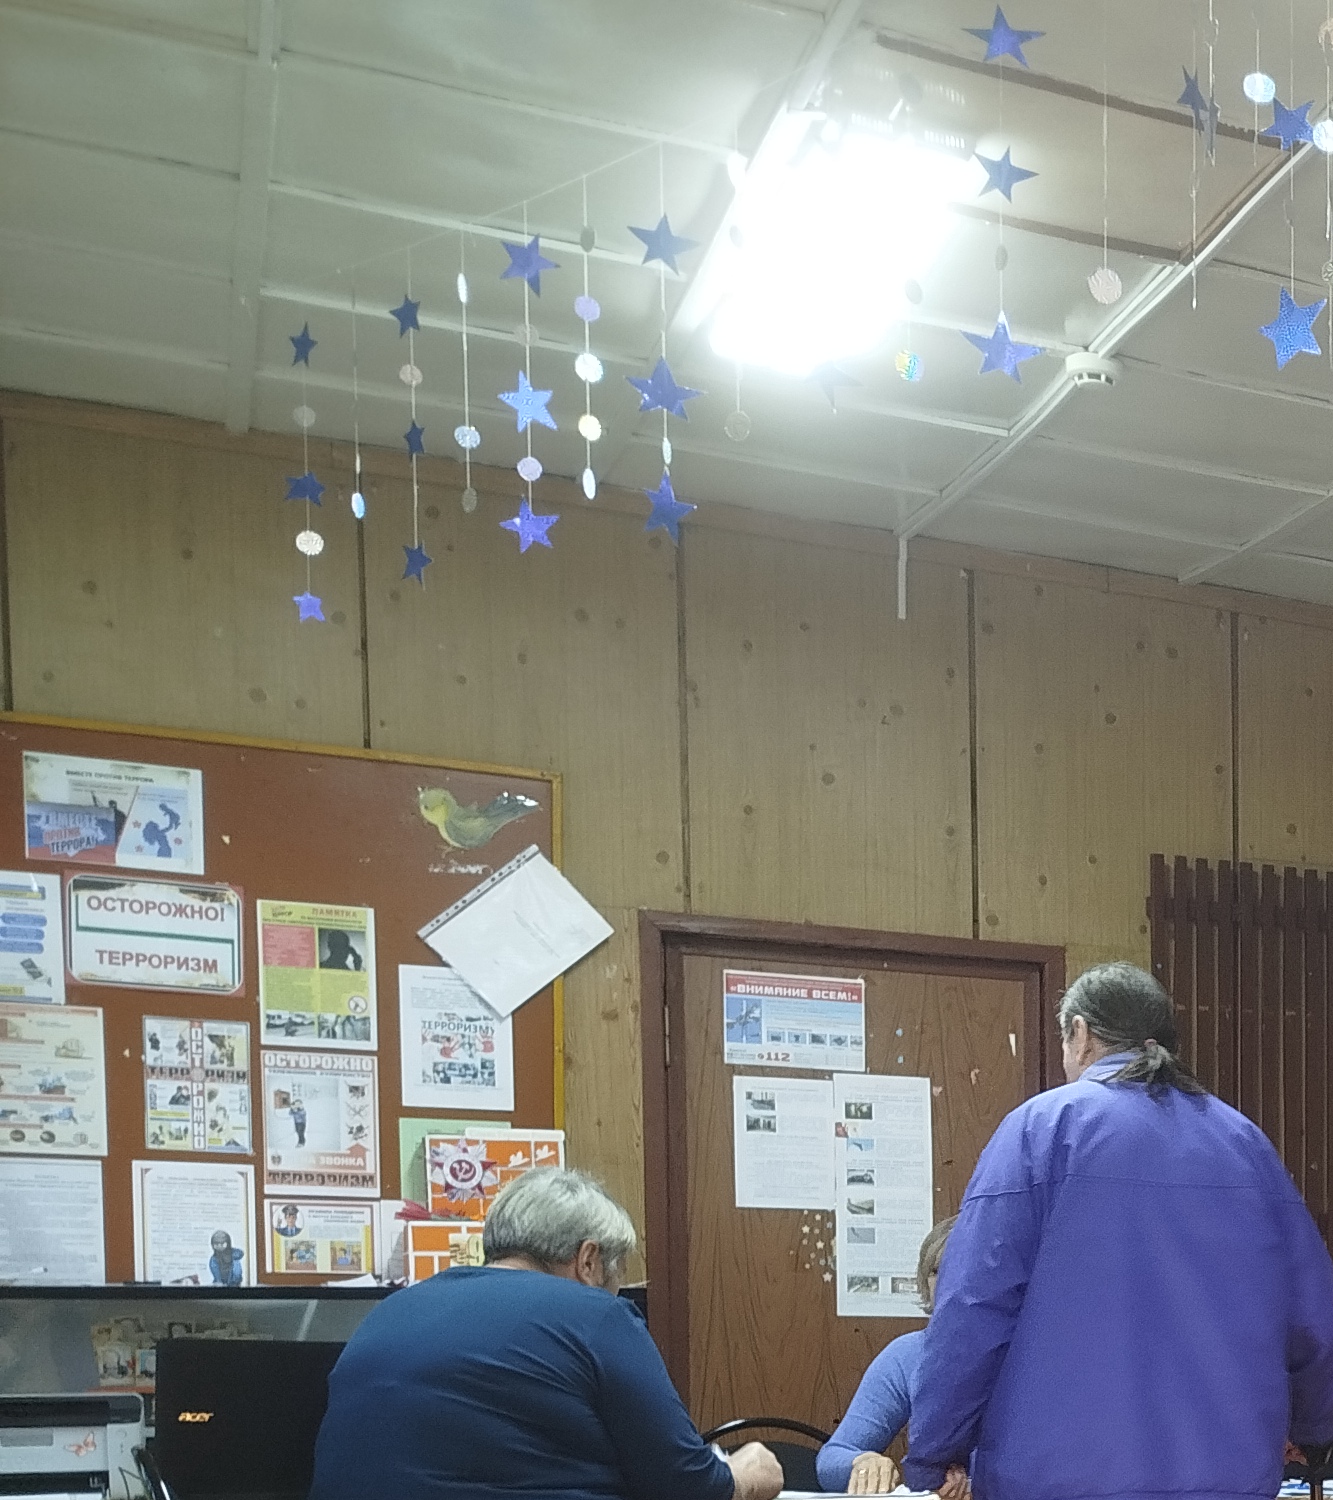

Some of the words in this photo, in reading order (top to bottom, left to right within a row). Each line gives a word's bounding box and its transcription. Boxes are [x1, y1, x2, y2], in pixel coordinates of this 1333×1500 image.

[86, 895, 225, 922] ОСТОРОЖНО!
[95, 949, 219, 974] ТЕРРОРИЗМ
[421, 1020, 495, 1034] ТЕРРОРИЗМУ
[264, 1053, 373, 1072] ОСТОРОЖНО
[766, 1051, 790, 1062] 112
[319, 1154, 365, 1167] ЗВОНКА
[268, 1171, 376, 1188] ТЕРРОРИЗМ
[178, 1411, 214, 1423] acer
